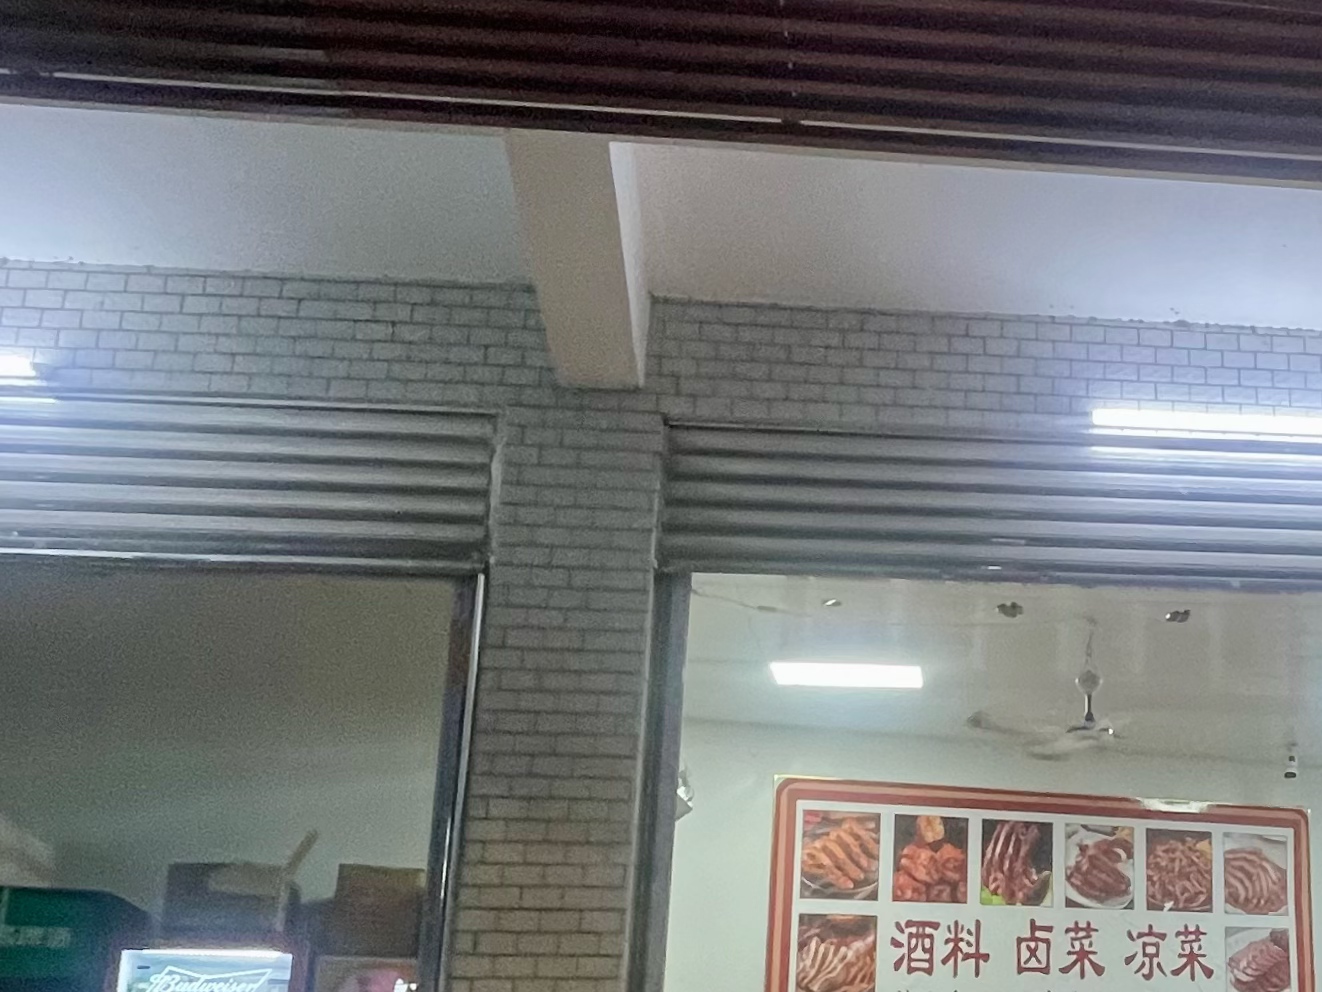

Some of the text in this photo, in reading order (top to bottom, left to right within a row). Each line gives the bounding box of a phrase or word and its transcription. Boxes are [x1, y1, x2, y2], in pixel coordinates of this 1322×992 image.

[891, 919, 1214, 981] 酒料 卤菜 凉菜
